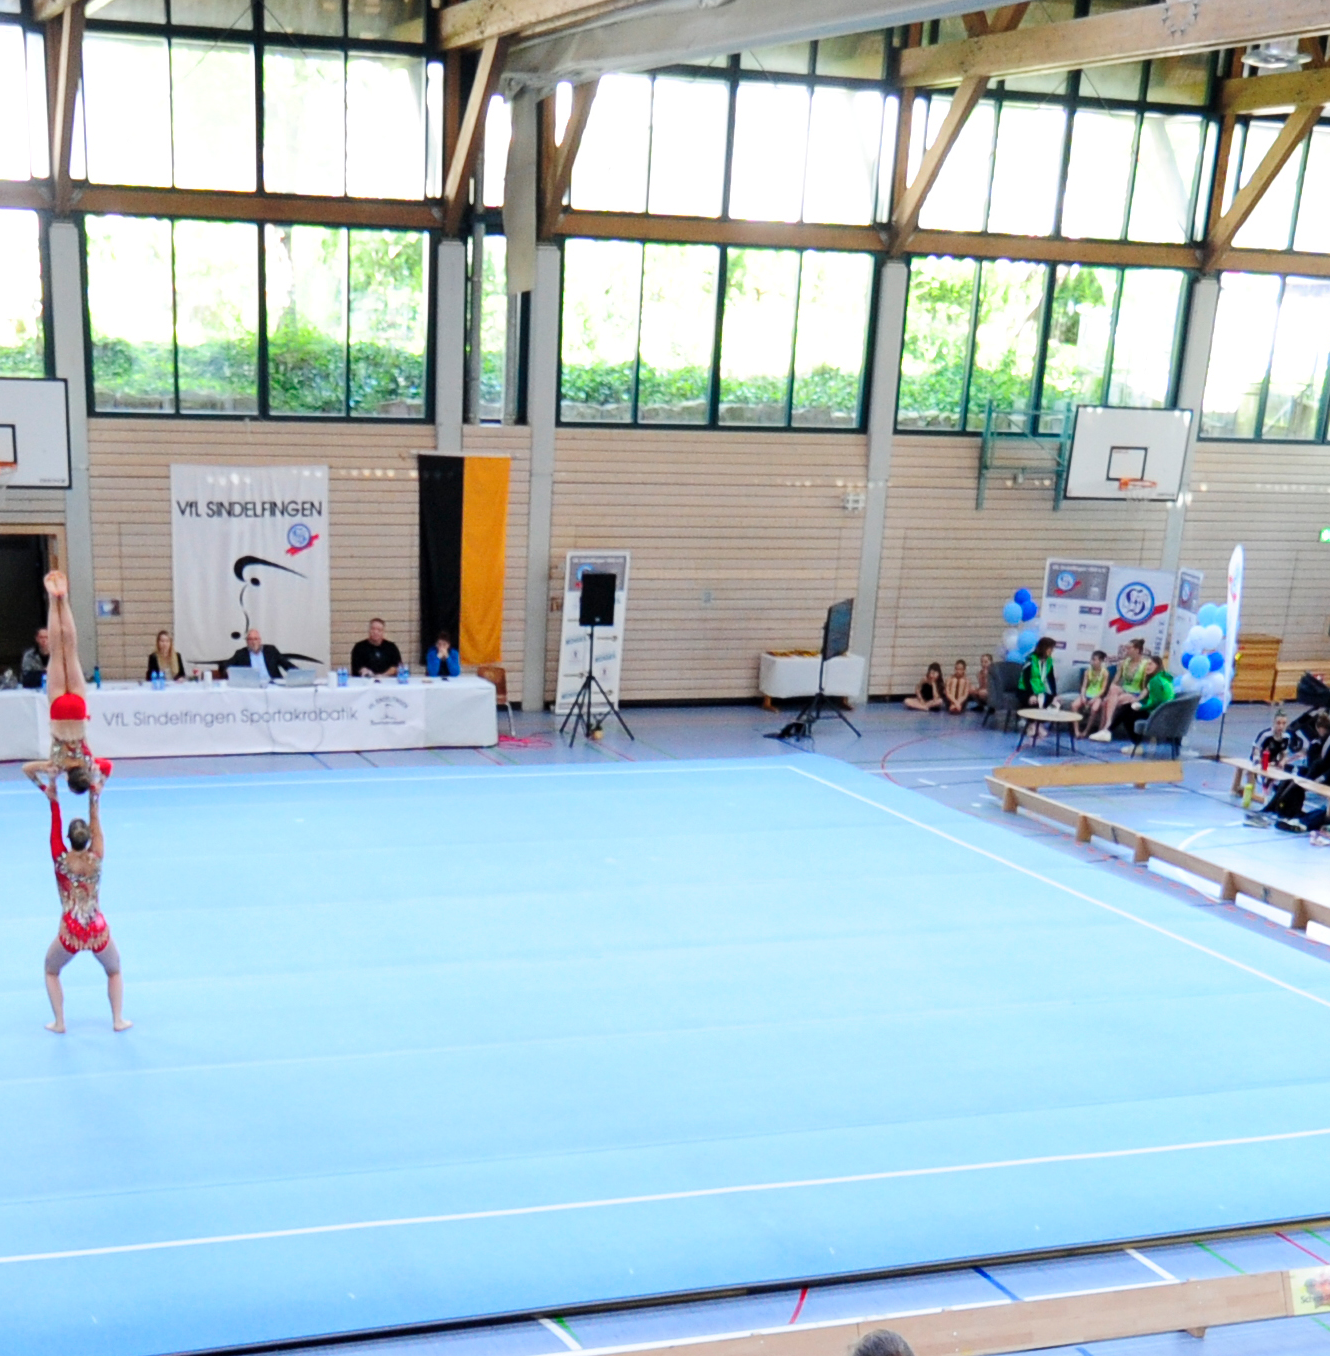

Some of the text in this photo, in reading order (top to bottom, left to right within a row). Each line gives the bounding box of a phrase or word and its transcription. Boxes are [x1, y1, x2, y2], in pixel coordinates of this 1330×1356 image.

[176, 500, 322, 518] VfL SINDELFINGEN
[133, 710, 236, 728] Sindelfingen
[240, 707, 358, 726] Sportakrobatik
